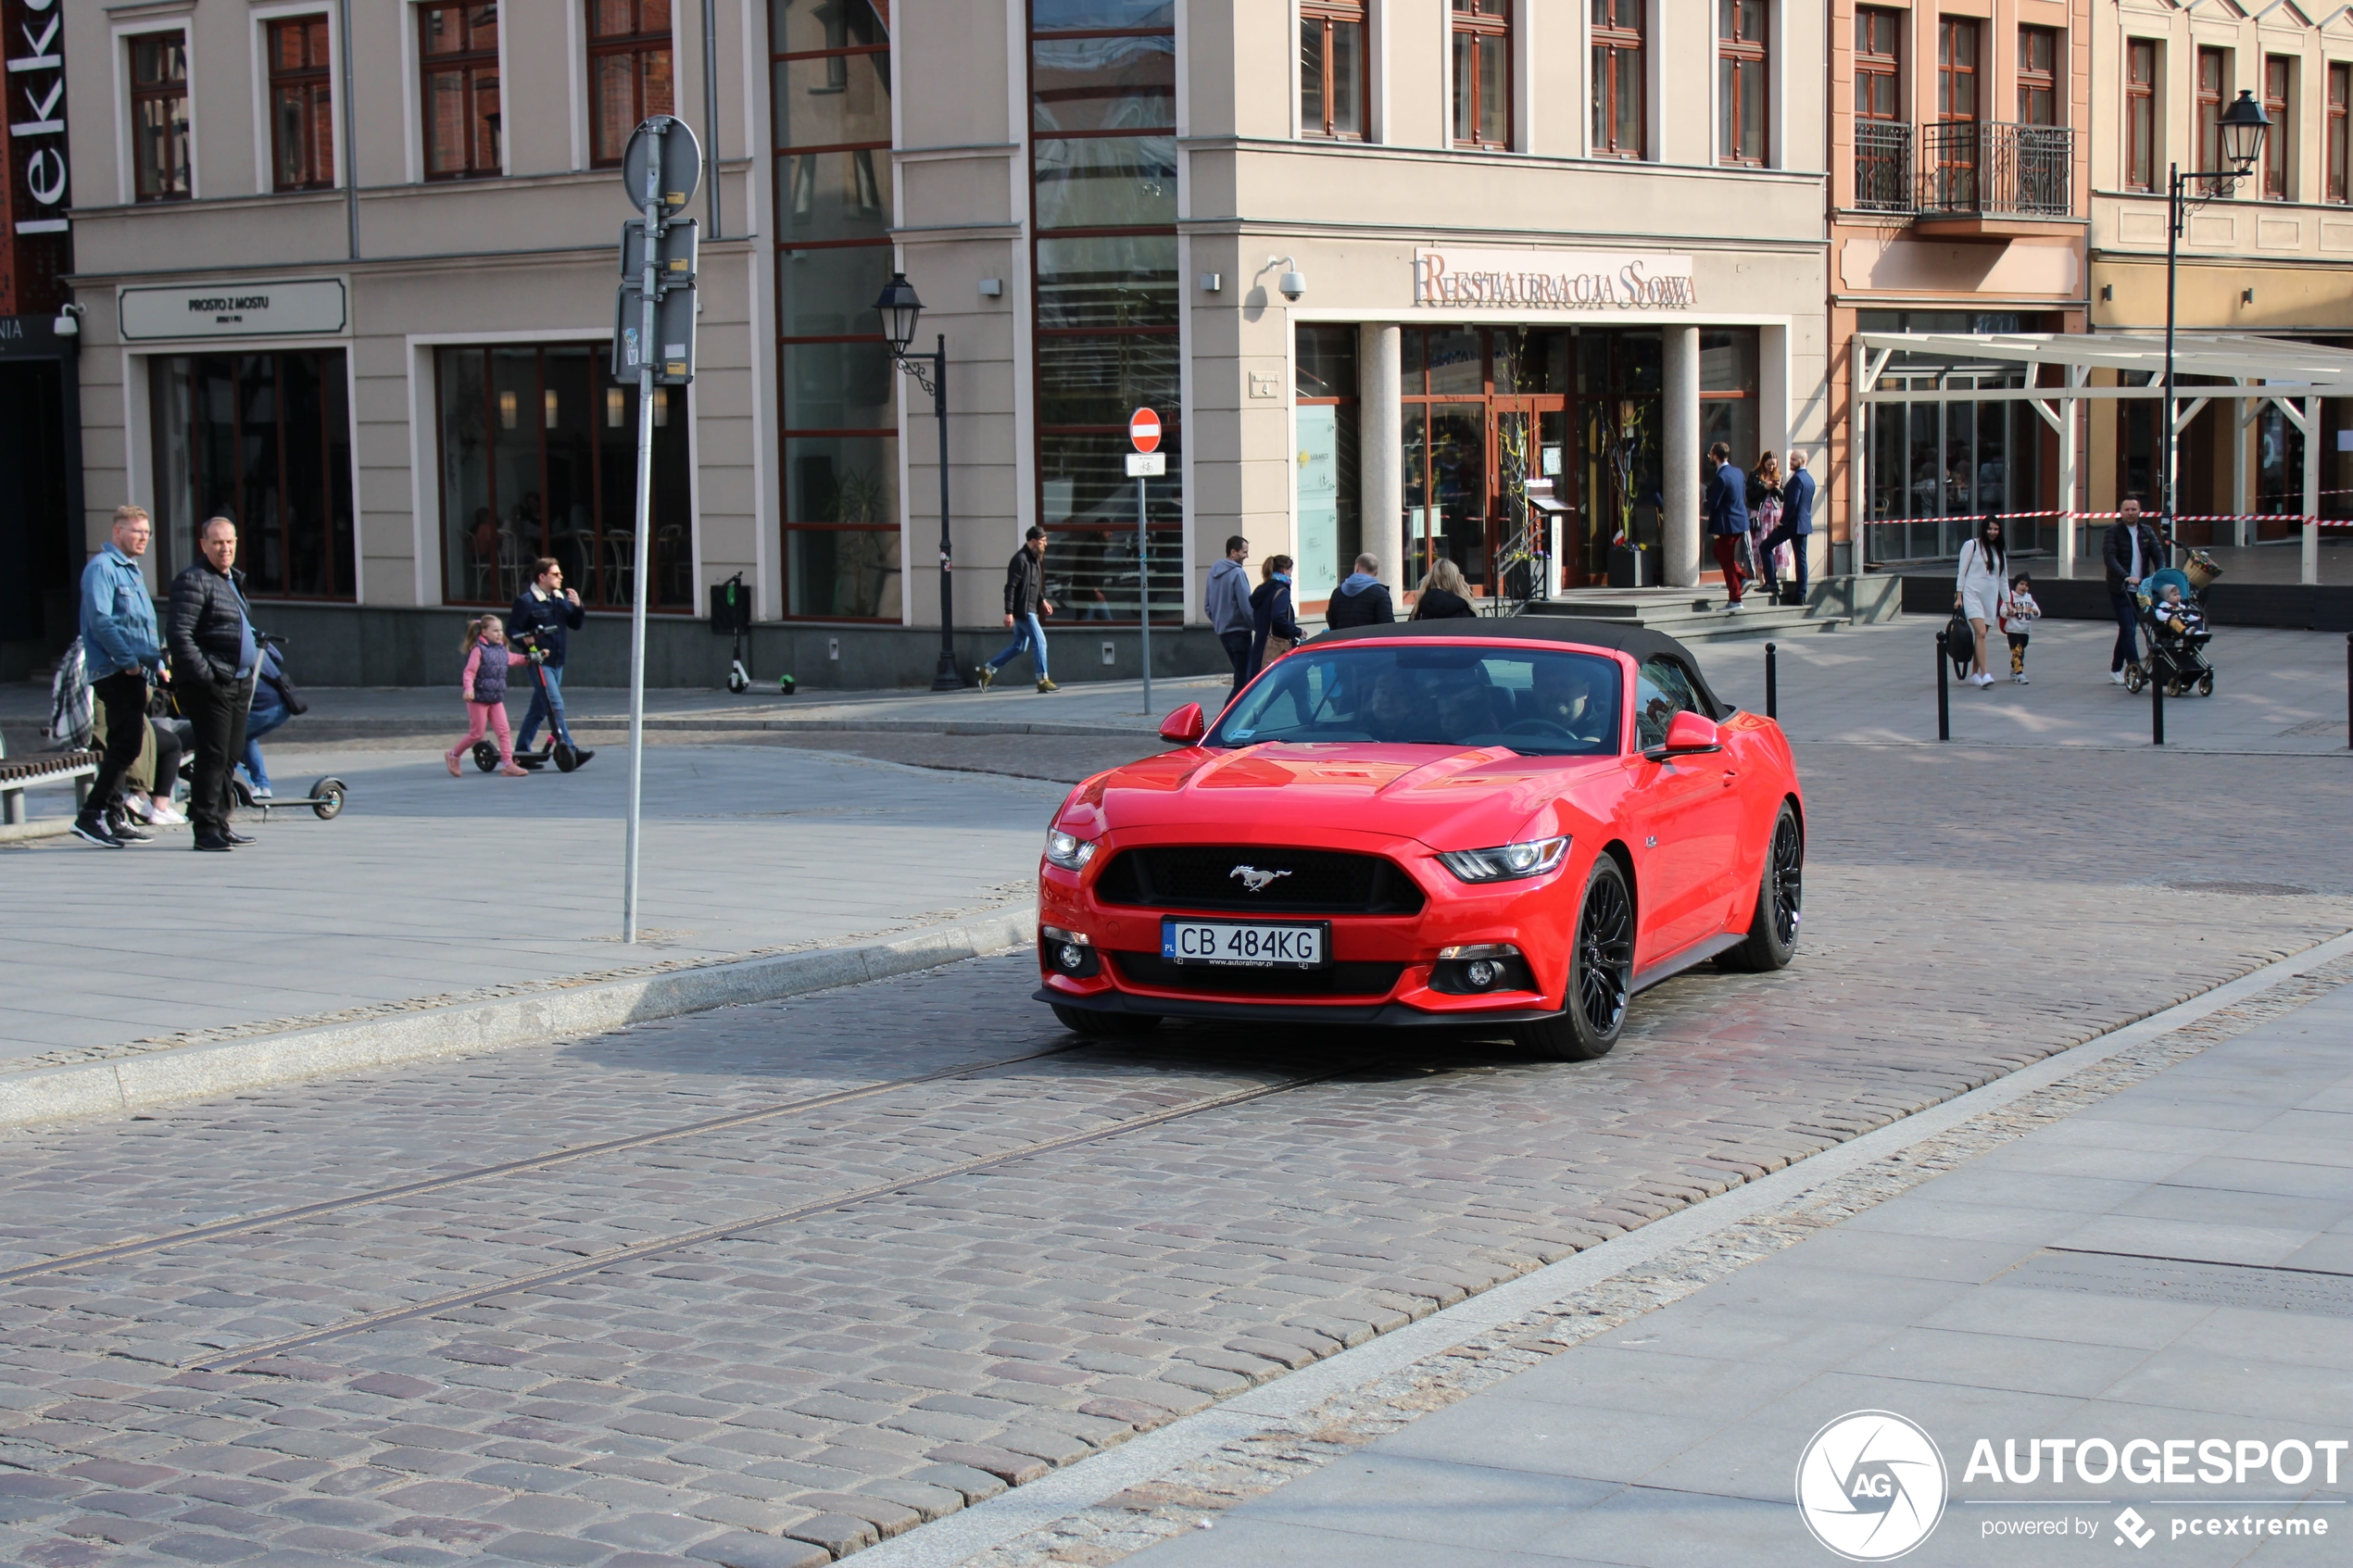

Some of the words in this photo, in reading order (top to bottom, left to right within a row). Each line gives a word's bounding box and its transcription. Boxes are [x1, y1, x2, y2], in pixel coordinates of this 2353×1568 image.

[6, 0, 69, 234] lekk
[1424, 253, 1616, 305] RESTAURACJA
[1629, 259, 1699, 306] SOWA
[188, 298, 227, 312] PROSTO
[228, 297, 233, 310] Z
[235, 295, 269, 309] MOSTU
[1261, 383, 1269, 395] 4
[1164, 944, 1175, 952] PL
[1181, 927, 1216, 956] CB
[1227, 929, 1313, 960] 484KG
